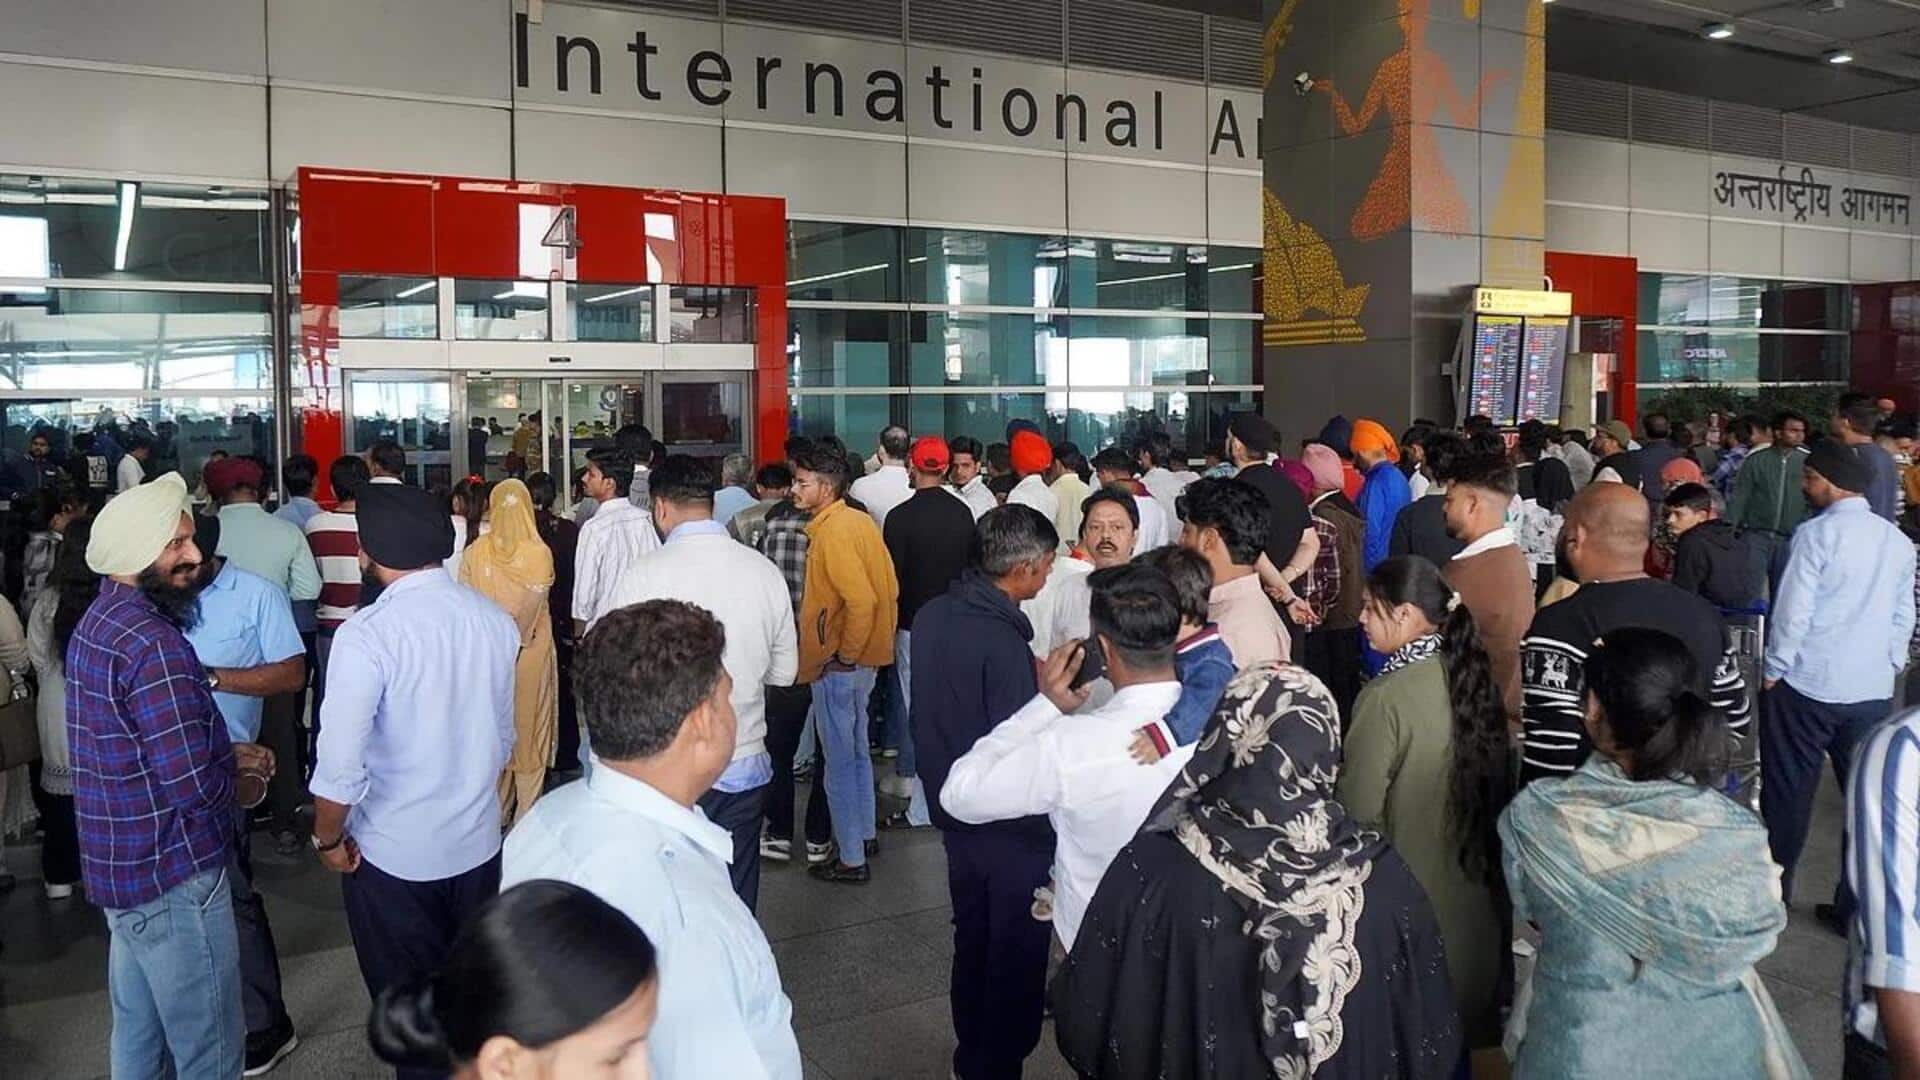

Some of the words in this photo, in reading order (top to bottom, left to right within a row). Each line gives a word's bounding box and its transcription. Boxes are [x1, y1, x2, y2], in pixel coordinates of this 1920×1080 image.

[516, 12, 1163, 150] International
[1714, 166, 1832, 222] अन्तर्राष्ट्रीय
[1840, 187, 1910, 224] आगमन
[541, 207, 584, 259] 4
